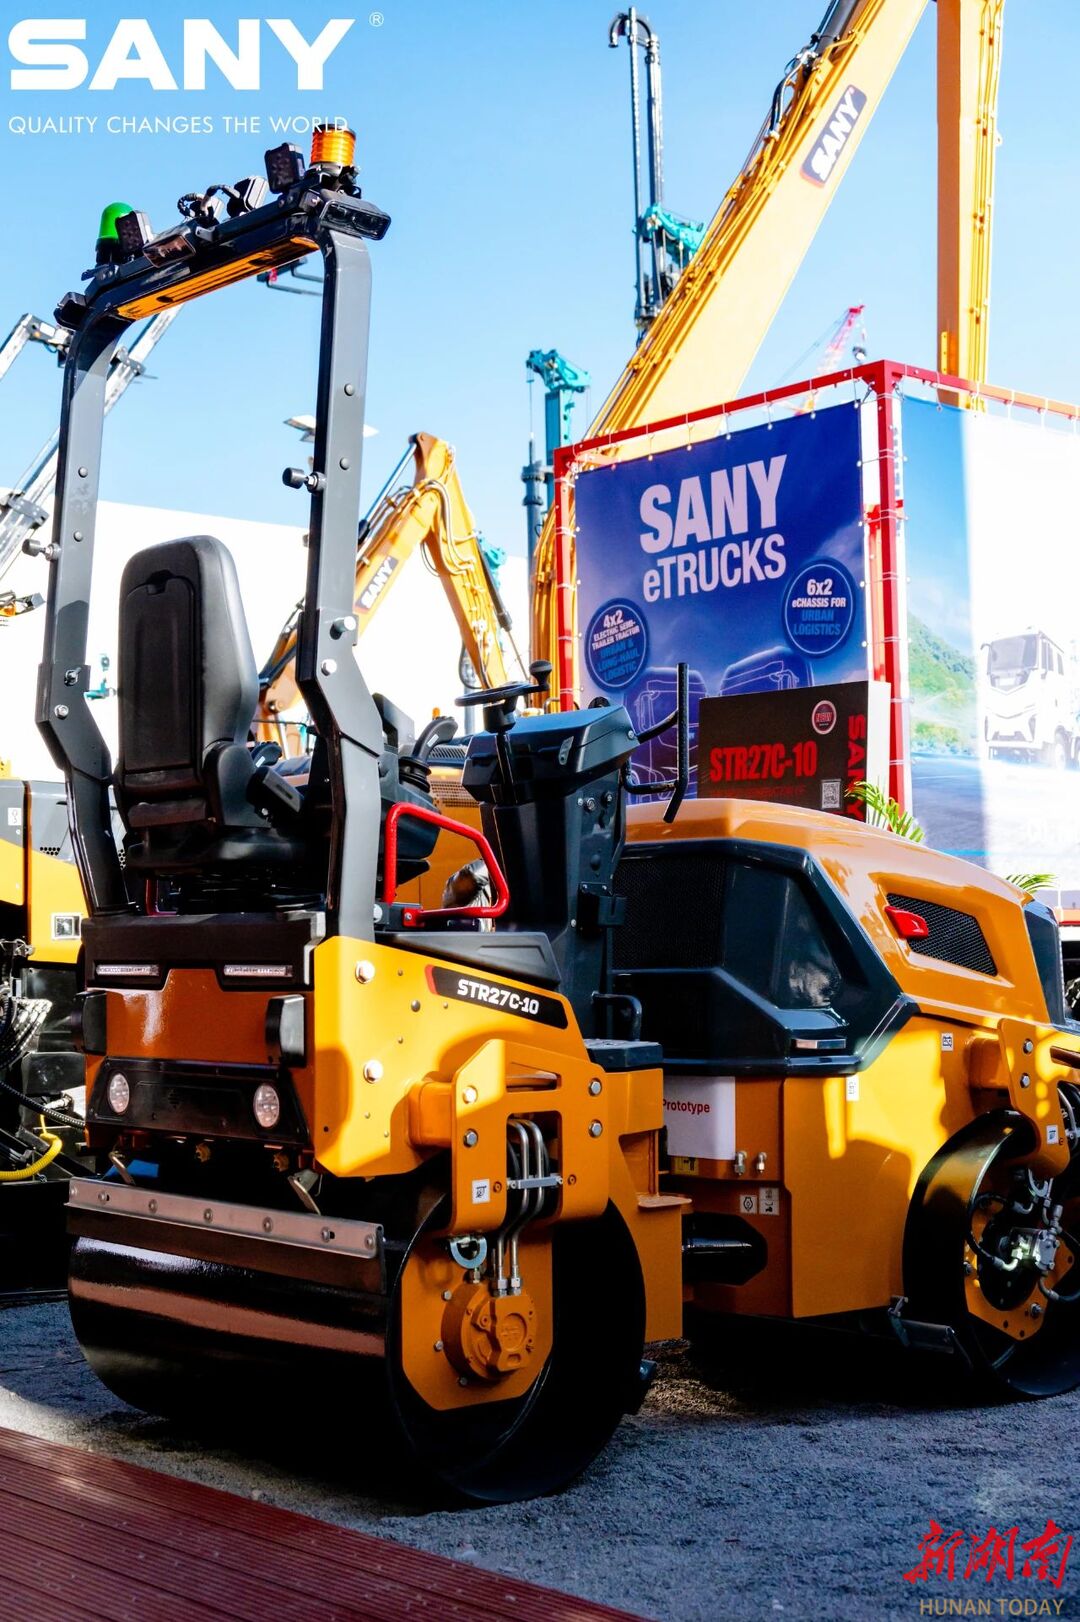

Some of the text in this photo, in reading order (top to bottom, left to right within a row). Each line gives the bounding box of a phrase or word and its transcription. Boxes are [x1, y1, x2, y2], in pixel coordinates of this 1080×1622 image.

[811, 89, 859, 181] SANY
[639, 454, 787, 554] SANY
[361, 558, 393, 609] SANY
[643, 533, 787, 603] eTRUCKS
[792, 597, 847, 608] eCHASSIS FOR
[806, 578, 833, 596] 6x2
[603, 609, 624, 628] 4x2
[793, 623, 841, 636] LOGISTICS
[801, 609, 835, 621] URBAN
[709, 740, 818, 783] STR27C-10
[457, 978, 540, 1015] STR27C-10
